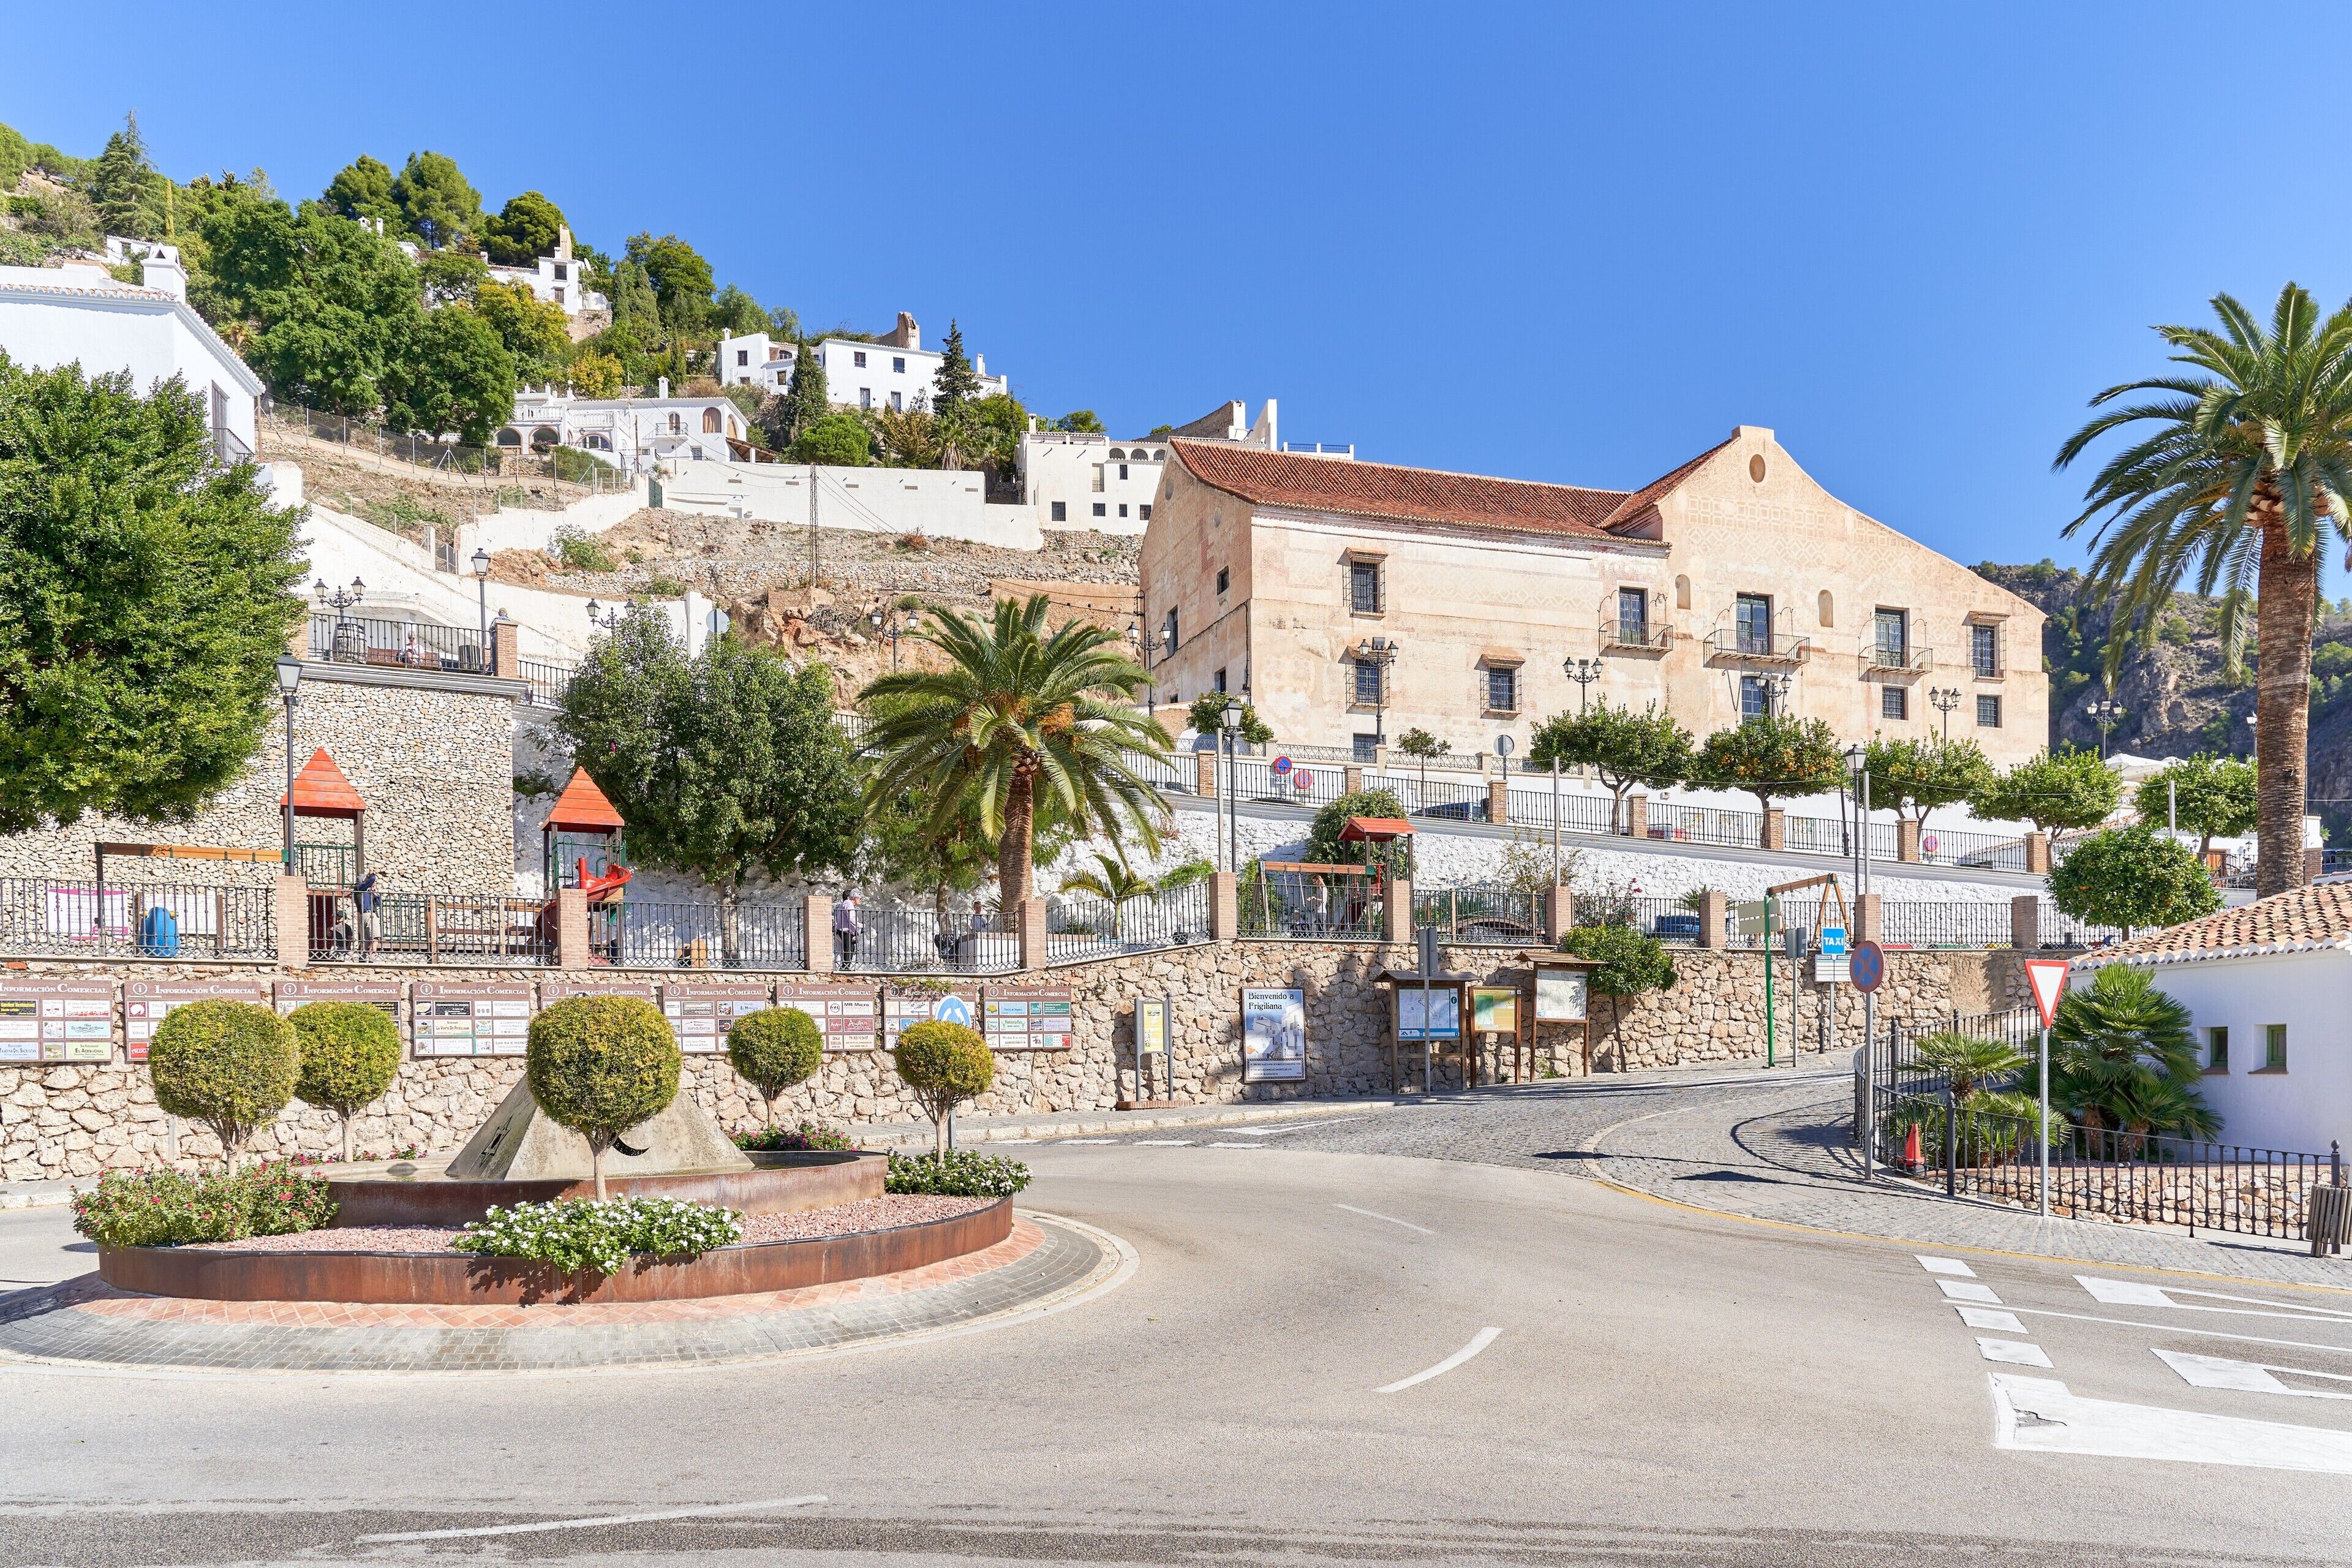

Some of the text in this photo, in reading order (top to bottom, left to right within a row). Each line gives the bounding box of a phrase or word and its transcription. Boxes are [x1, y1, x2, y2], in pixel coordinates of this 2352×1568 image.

[1824, 937, 1844, 946] TAXI
[57, 983, 108, 993] COMERCIAL
[154, 984, 257, 994] INFORMACIÓN COMERCIAL
[303, 985, 398, 994] INFORMACIÓN COMERCIAL
[439, 986, 527, 995] INFORMACIÓN COMERCIAL
[609, 987, 647, 995] COMERCIAL
[1248, 1002, 1282, 1011] Frigiliana
